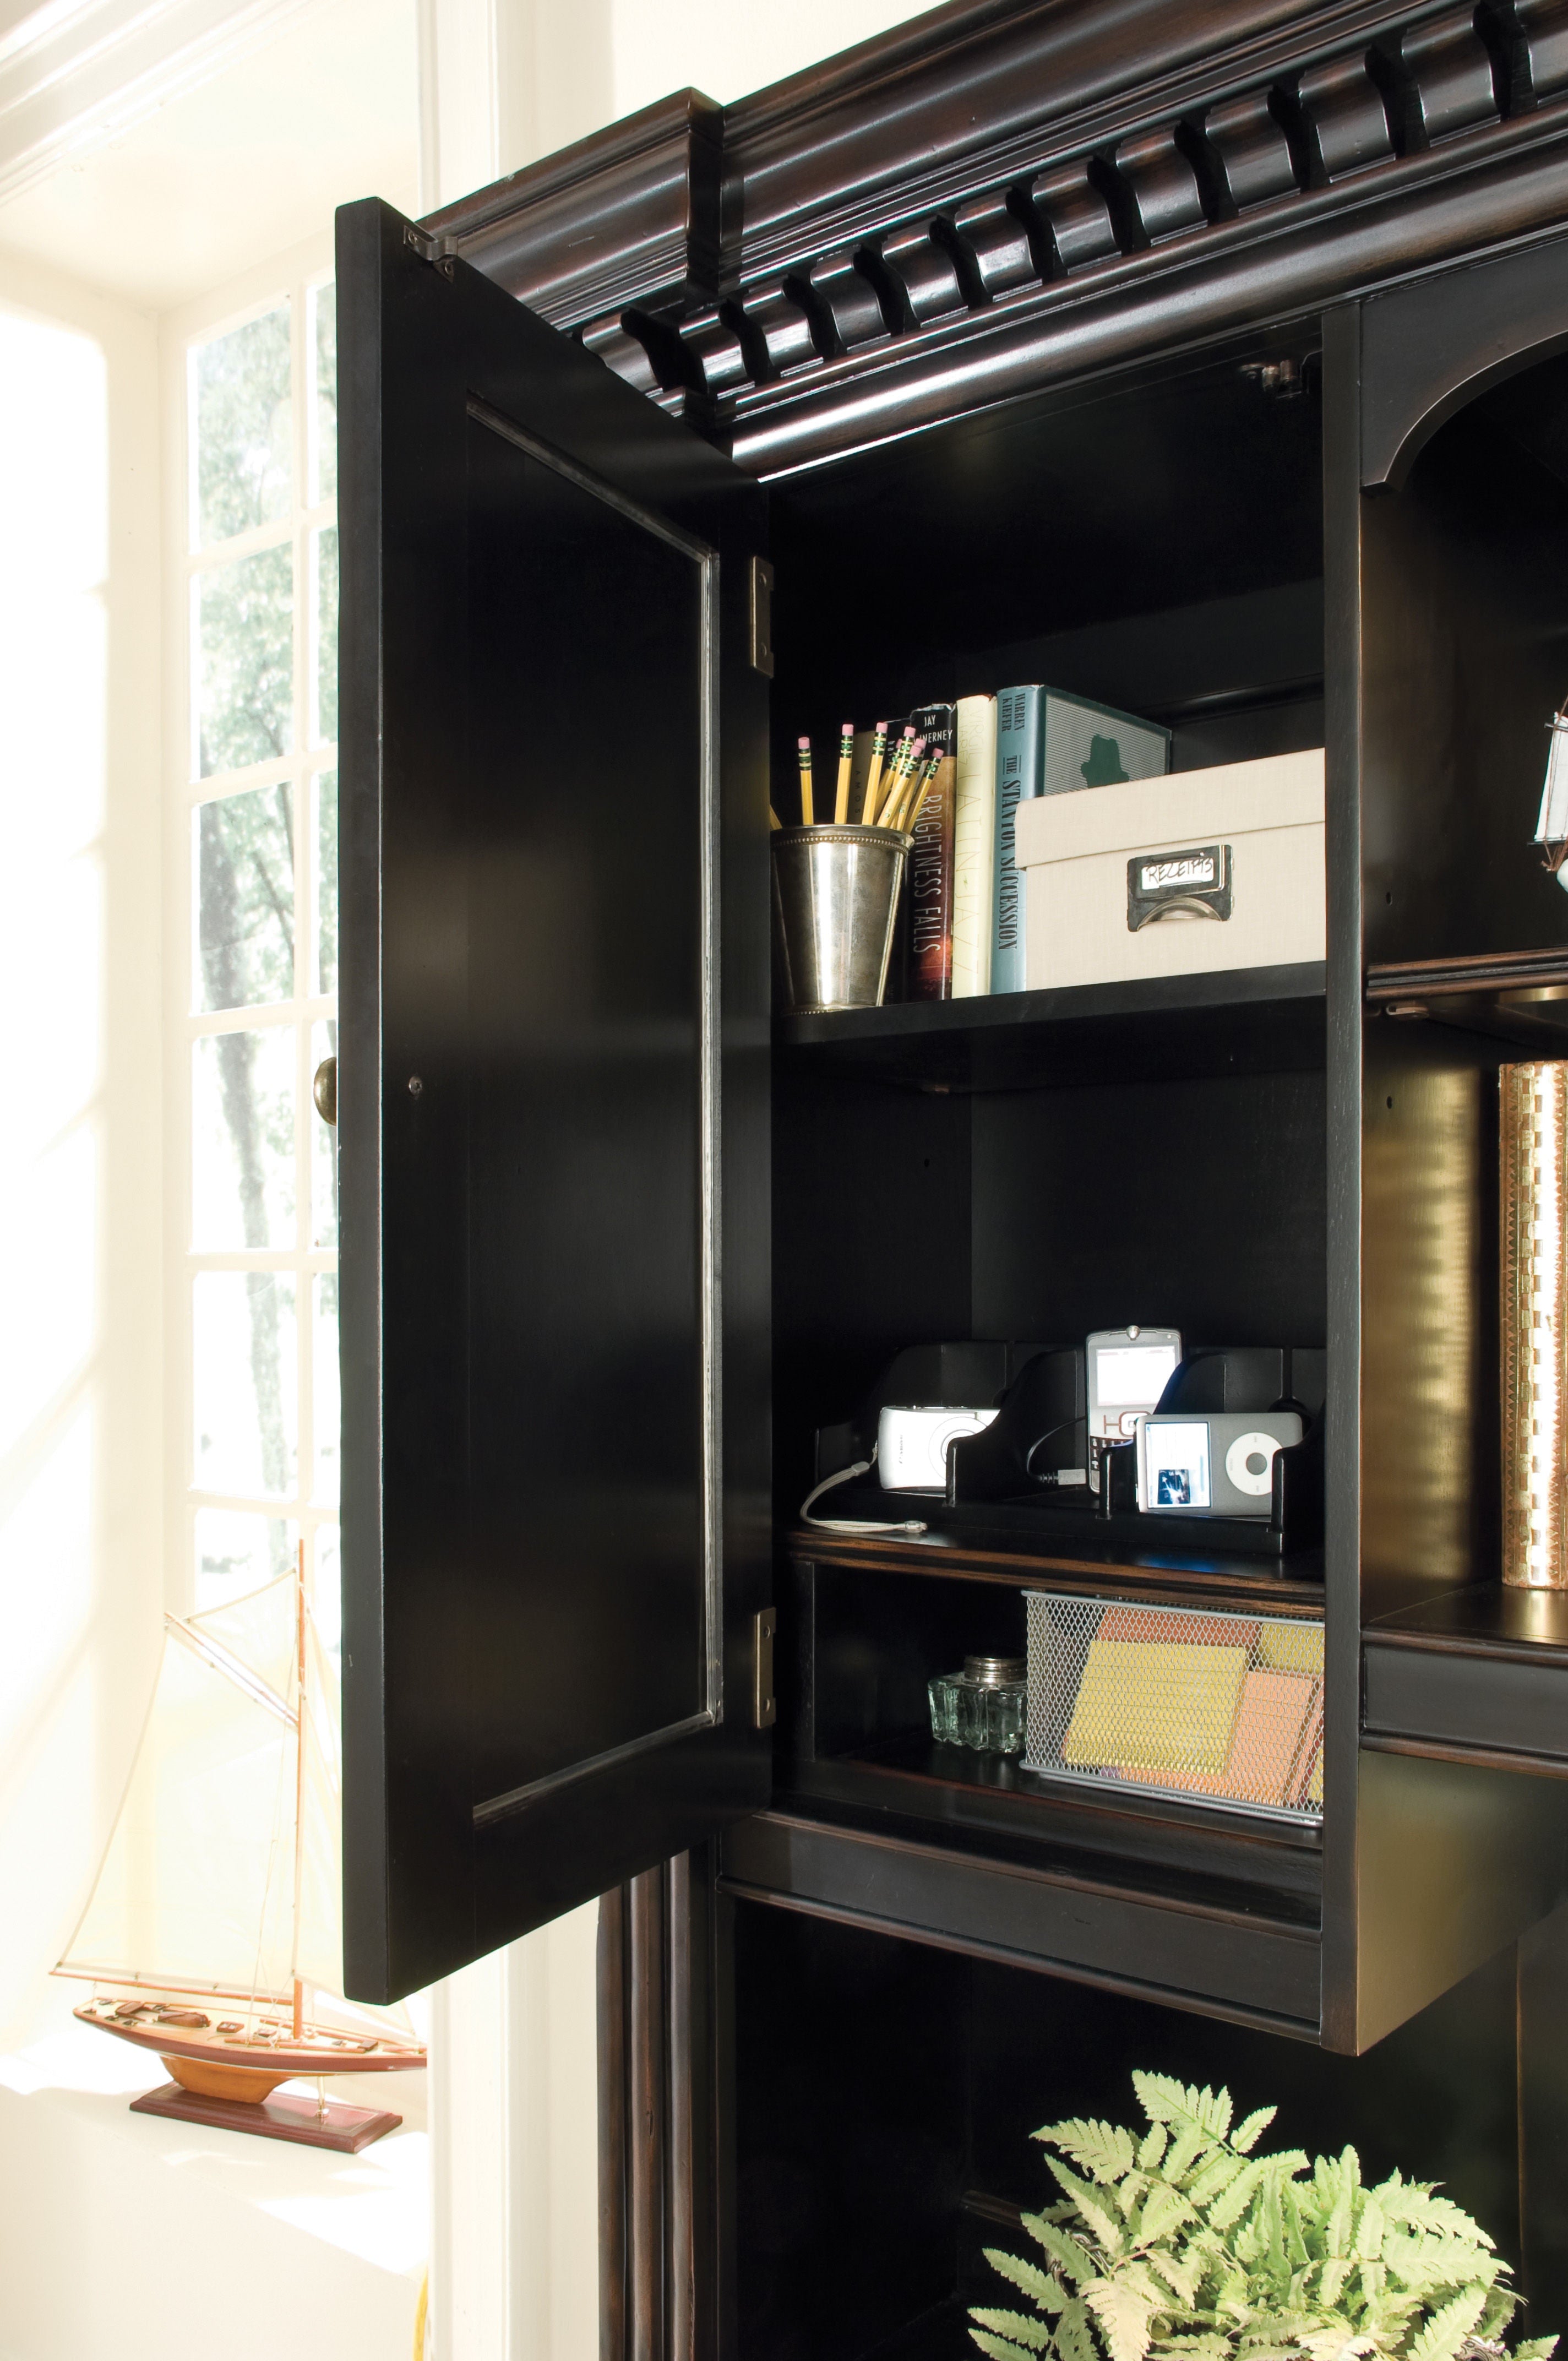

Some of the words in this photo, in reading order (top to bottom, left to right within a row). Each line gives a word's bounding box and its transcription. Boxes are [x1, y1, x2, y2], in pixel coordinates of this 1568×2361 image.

[924, 714, 936, 727] JAY
[968, 709, 984, 757] VIRGIL
[1001, 697, 1012, 732] KIEFER
[1014, 693, 1026, 731] WARREN
[1006, 755, 1017, 775] THE
[914, 794, 943, 897] BRIGHTNESS
[956, 774, 982, 872] LATIN
[1146, 857, 1213, 884] RECEIPTS
[998, 856, 1019, 950] SUCCESSION
[913, 906, 943, 954] FALLS
[953, 893, 980, 974] JAZZ
